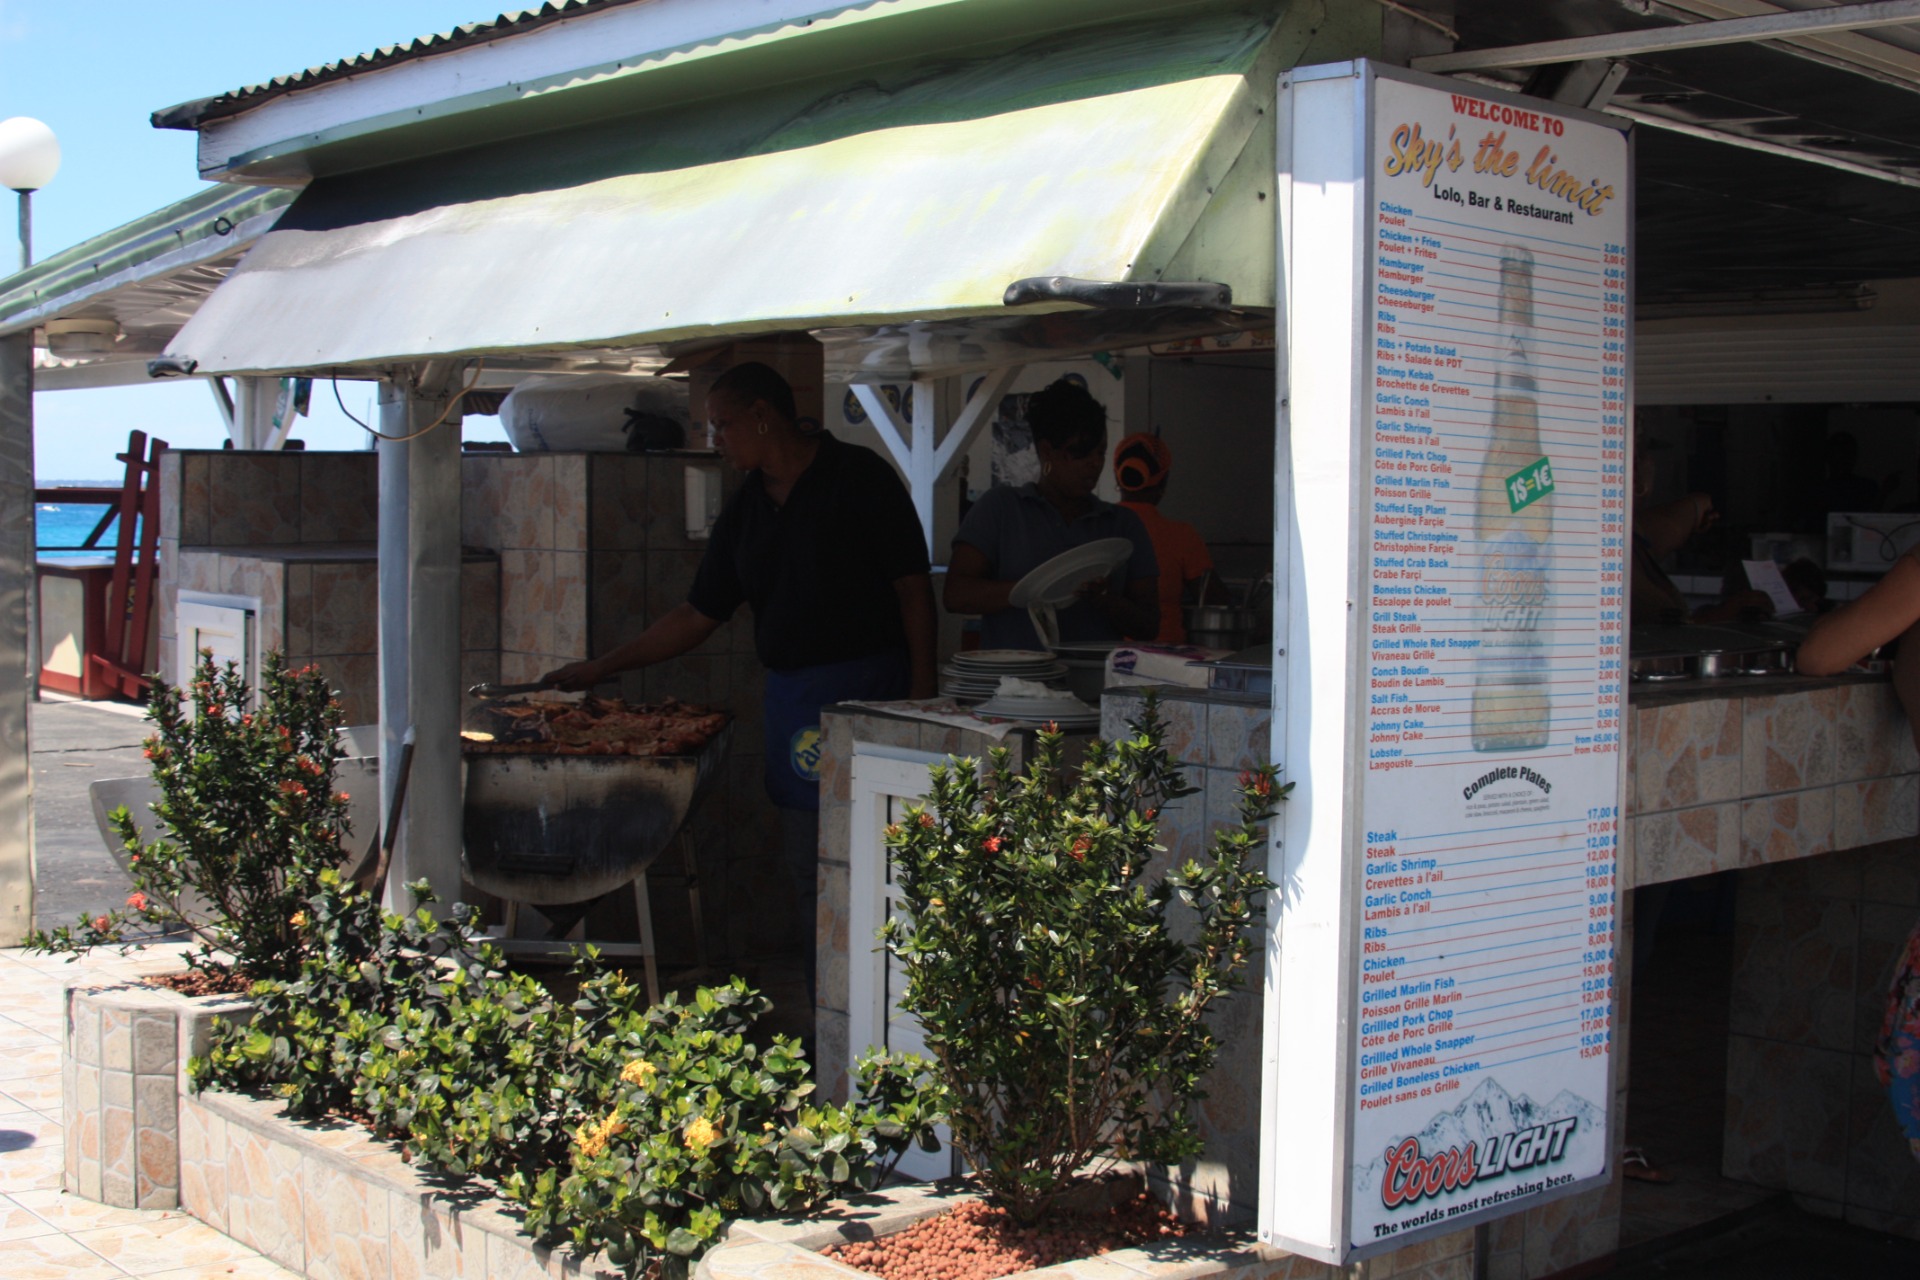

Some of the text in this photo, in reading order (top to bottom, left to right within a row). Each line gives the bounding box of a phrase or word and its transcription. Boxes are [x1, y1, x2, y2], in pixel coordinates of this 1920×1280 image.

[1451, 95, 1563, 137] WELCOME TO
[1384, 122, 1614, 216] Sky's the limit
[1380, 202, 1412, 216] Chicken
[1434, 184, 1573, 224] Lolo, Bar & Restaurant
[1379, 214, 1405, 227] Poulet
[1380, 229, 1441, 249] Chicken Fries
[1379, 242, 1437, 259] Poulet Frites
[1379, 257, 1424, 272] Hamburger
[1604, 254, 1618, 264] 2,00
[1378, 269, 1423, 284] Hamburger
[1378, 284, 1435, 301] Cheeseburger
[1378, 296, 1434, 312] Cheeseburger
[1378, 311, 1396, 322] Ribs
[1378, 323, 1395, 334] Ribs
[1378, 338, 1456, 356] Ribs Potato Salad
[1377, 351, 1462, 368] Ribs Salade PDT
[1377, 366, 1434, 380] Shrimp Kebab
[1377, 378, 1469, 396] Brochette Crevettes
[1376, 394, 1429, 406] Garlic Conch
[1376, 405, 1405, 416] Lambis
[1376, 421, 1432, 434] Garlic Shrimp
[1376, 433, 1415, 443] Crevettes
[1376, 448, 1447, 462] Grilled Pork Chop
[1410, 462, 1428, 471] Porc
[1376, 476, 1449, 488] Grilled Marlin Fish
[1375, 488, 1406, 498] Poisson
[1375, 503, 1446, 516] Stuffed Egg Plant
[1374, 515, 1416, 527] Aubergine
[1375, 530, 1458, 542] Stuffed Christophine
[1374, 542, 1426, 554] Christophine
[1374, 558, 1448, 568] Stuffed Crab Back
[1374, 570, 1398, 578] Crabe
[1482, 552, 1550, 603] Coors
[1374, 585, 1446, 594] Boneless Chicken
[1373, 597, 1451, 608] Escalope poulet
[1373, 612, 1416, 621] Grill Steak
[1482, 604, 1543, 631] LIGHT
[1373, 624, 1396, 633] Steak
[1373, 639, 1400, 648] Grilled
[1403, 639, 1428, 648] Whole
[1431, 639, 1445, 647] Red
[1448, 639, 1480, 649] Snapper
[1372, 651, 1410, 661] Vivaneau
[1372, 666, 1429, 676] Conch Boudin
[1372, 677, 1444, 688] Boudin Lambis
[1372, 694, 1408, 703] Salt Fish
[1371, 704, 1440, 715] Accras Morue
[1371, 720, 1424, 732] Johnny Cake
[1370, 732, 1423, 743] Johnny Cake
[1370, 749, 1402, 758] Lobster
[1370, 760, 1413, 771] Langouste
[1463, 765, 1551, 800] Complete Plates
[1588, 807, 1610, 820] 17,00
[1367, 831, 1397, 843] Steak
[1587, 836, 1609, 848] 12,00
[1367, 846, 1396, 859] Steak
[1366, 859, 1437, 876] Garlic Shrimp
[1586, 864, 1609, 877] 18,00
[1366, 875, 1414, 890] Crevettes
[1365, 889, 1431, 908] Garlic Conch
[1365, 908, 1401, 920] Lambis
[1590, 906, 1607, 919] 9,00
[1364, 927, 1387, 939] Ribs
[1589, 934, 1606, 946] 8,00
[1364, 942, 1386, 953] Ribs
[1363, 956, 1405, 971] Chicken
[1363, 971, 1395, 984] Poulet
[1363, 976, 1454, 1003] Grilled Marlin Fish
[1362, 1003, 1400, 1018] Poisson
[1433, 992, 1462, 1005] Marlin
[1402, 1014, 1426, 1026] Pork
[1428, 1009, 1453, 1022] Chop
[1581, 1019, 1603, 1032] 17,00
[1403, 1026, 1424, 1040] Porc
[1401, 1044, 1431, 1058] Whole
[1435, 1034, 1476, 1052] Snapper
[1580, 1045, 1602, 1059] 15,00
[1391, 1056, 1435, 1073] Vivaneau
[1361, 1061, 1480, 1095] Grilled Boneless Chicken
[1361, 1097, 1392, 1110] Poulet
[1395, 1090, 1417, 1102] sans
[1420, 1087, 1431, 1096] os
[1383, 1117, 1576, 1207] Coors LIGHT
[1374, 1173, 1574, 1238] The worlds most refreshing beer.
